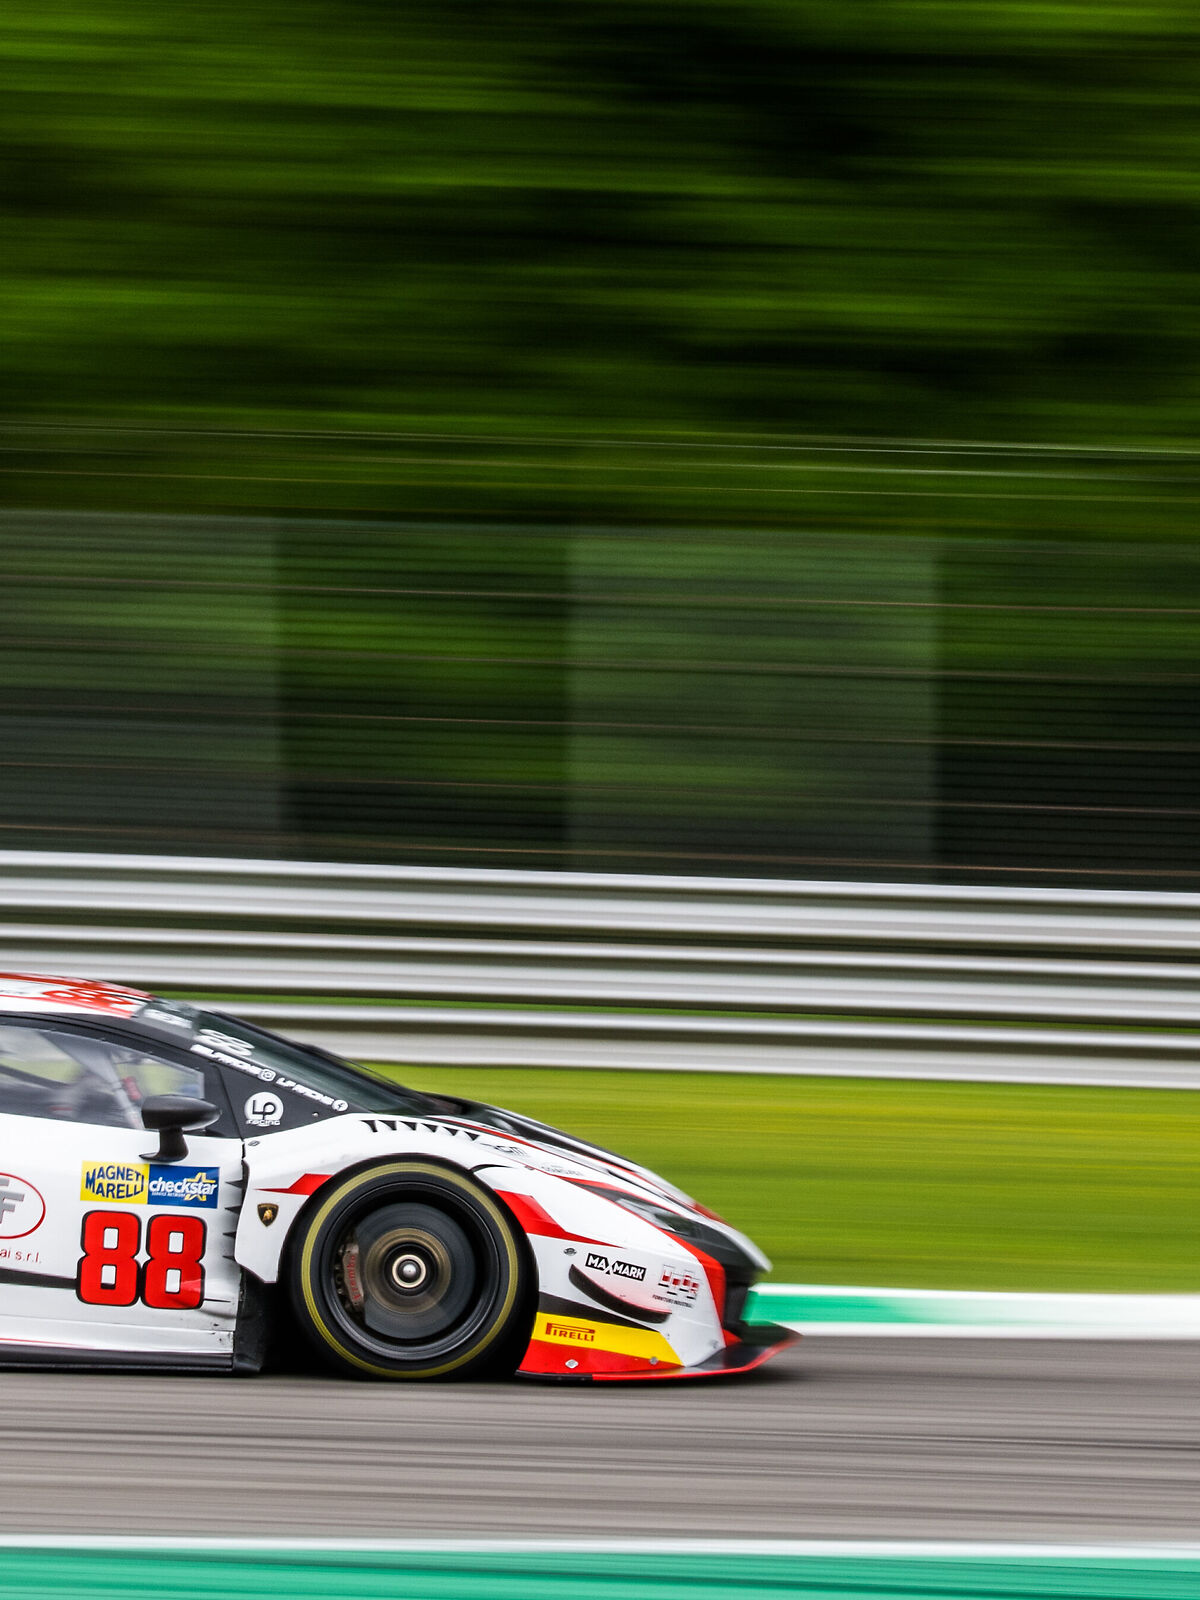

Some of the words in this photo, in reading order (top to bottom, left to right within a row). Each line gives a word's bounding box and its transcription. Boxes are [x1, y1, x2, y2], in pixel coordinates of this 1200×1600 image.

[252, 1100, 276, 1120] LP
[86, 1166, 144, 1187] MAGNETI
[149, 1176, 218, 1195] checkstar
[86, 1176, 144, 1199] MARELLI
[15, 1250, 42, 1264] s.r.l.
[76, 1210, 207, 1310] 88
[587, 1255, 646, 1281] MAXMARK
[545, 1322, 596, 1342] PIRELLI
